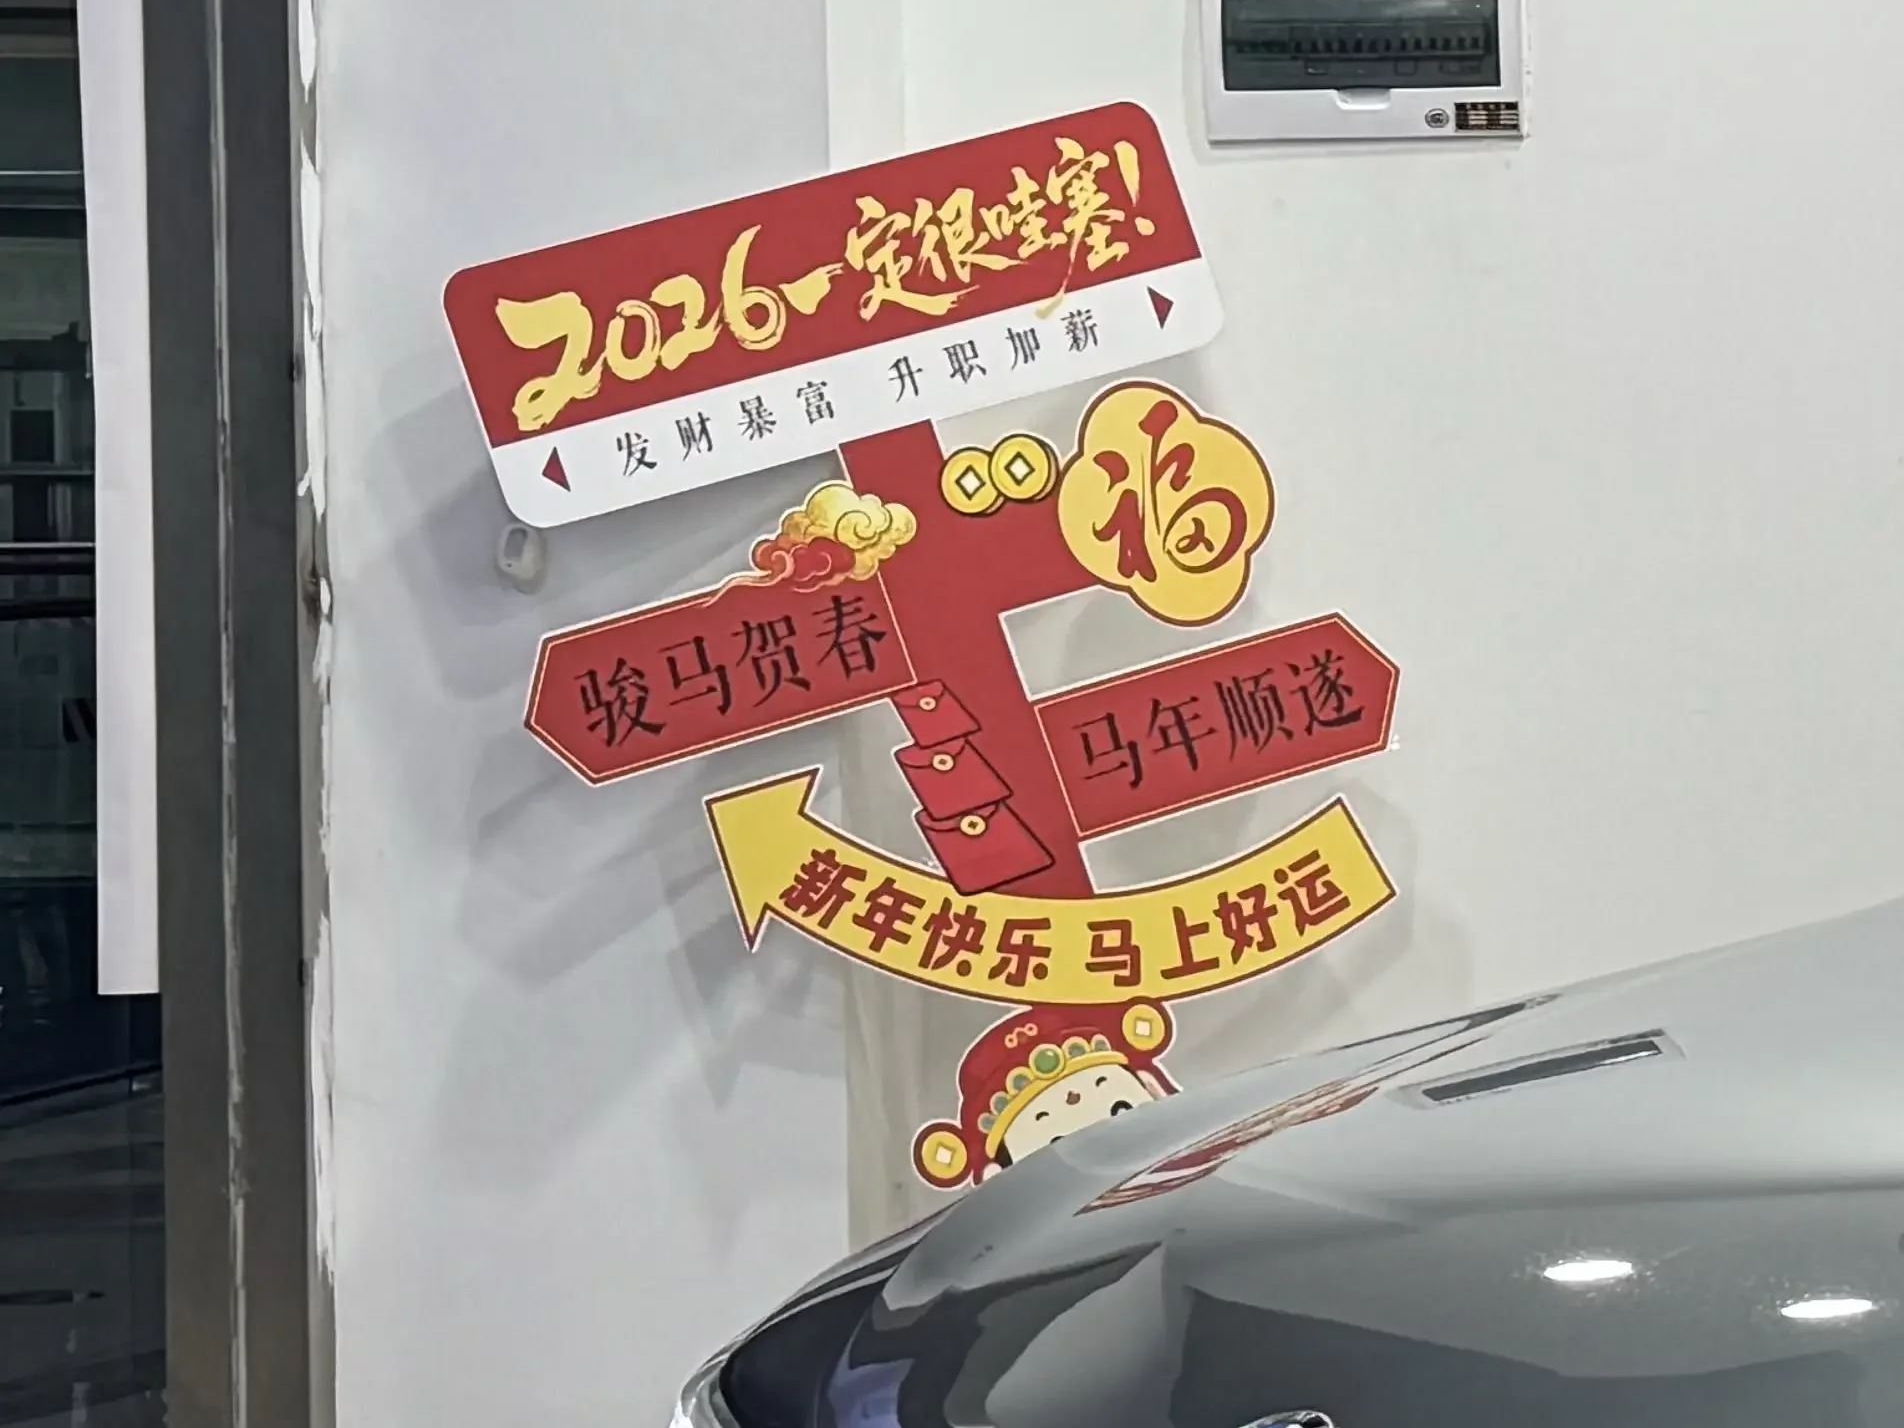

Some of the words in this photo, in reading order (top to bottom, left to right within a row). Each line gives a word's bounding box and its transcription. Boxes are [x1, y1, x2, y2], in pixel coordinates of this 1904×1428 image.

[617, 385, 837, 476] 发财暴富
[887, 309, 1101, 402] 升职加薪
[1096, 401, 1246, 584] 福
[575, 594, 886, 749] 骏马贺春
[1078, 659, 1365, 791] 马年顺遂
[779, 849, 1051, 983] 新年快乐
[1086, 850, 1348, 987] 马上好运
